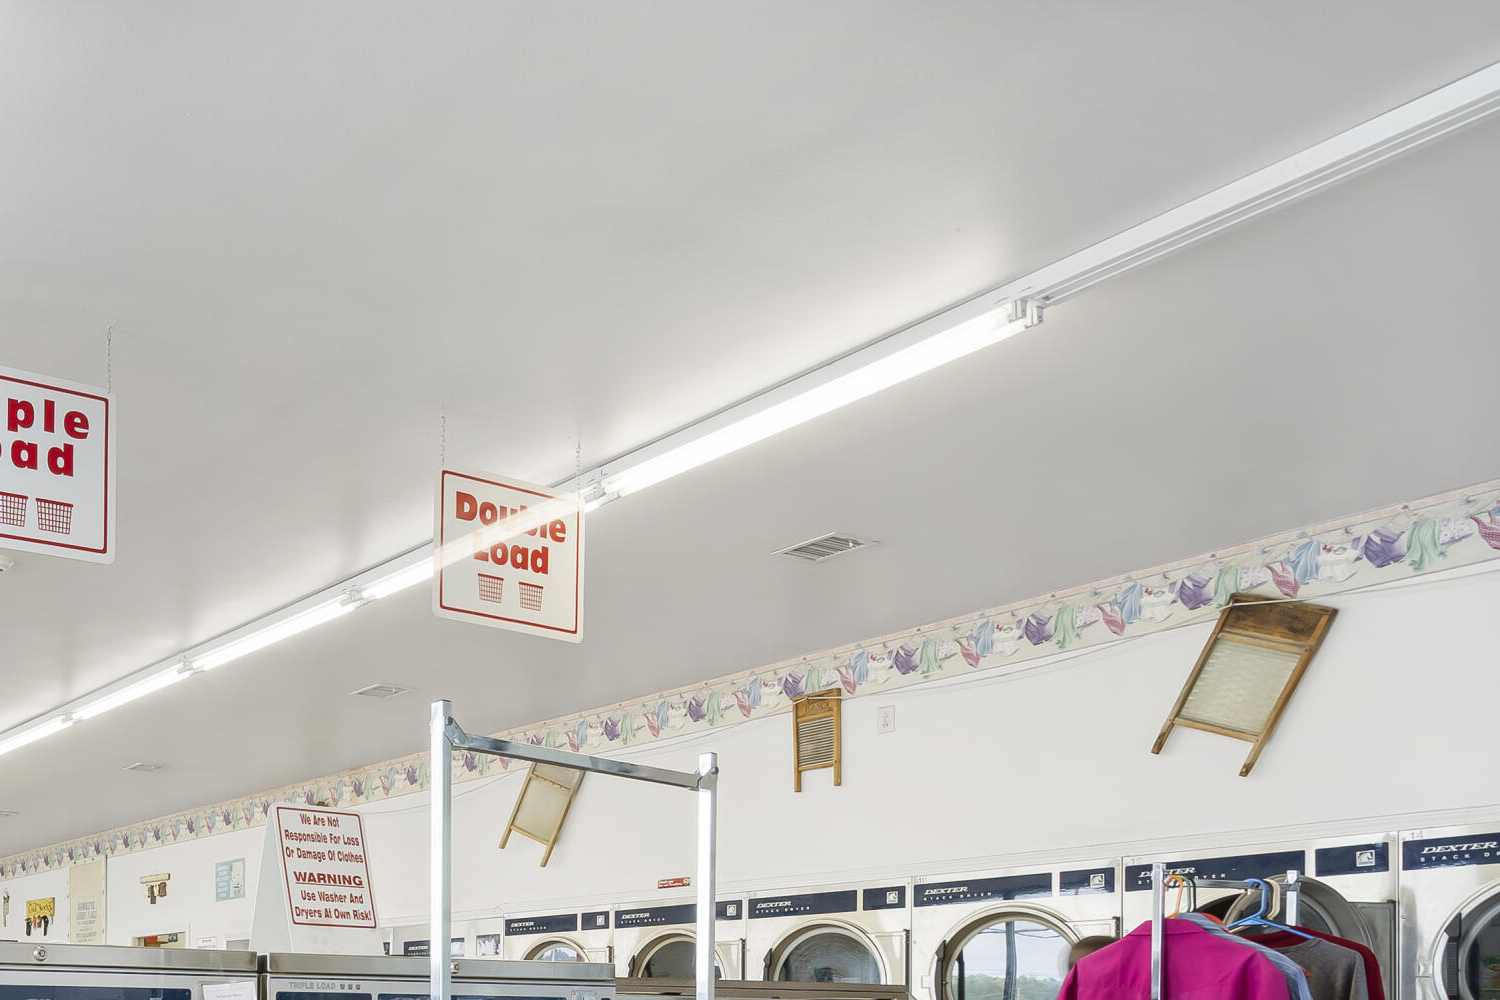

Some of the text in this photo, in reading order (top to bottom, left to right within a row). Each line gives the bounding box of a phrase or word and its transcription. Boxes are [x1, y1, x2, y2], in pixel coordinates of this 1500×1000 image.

[300, 813, 340, 828] We Are Not
[284, 829, 359, 846] Responsible For Loss
[1420, 841, 1498, 854] DEXTER
[285, 846, 364, 863] Or Damage Of Clothes
[1420, 854, 1470, 862] STACK
[293, 871, 363, 886] WARNING
[1138, 867, 1196, 878] DTER
[300, 890, 364, 904] Use Washer And
[923, 886, 969, 895] DEXTER
[756, 901, 792, 909] DEXTER
[294, 906, 372, 921] Dryers At Own Risk!
[316, 982, 336, 990] LOAD
